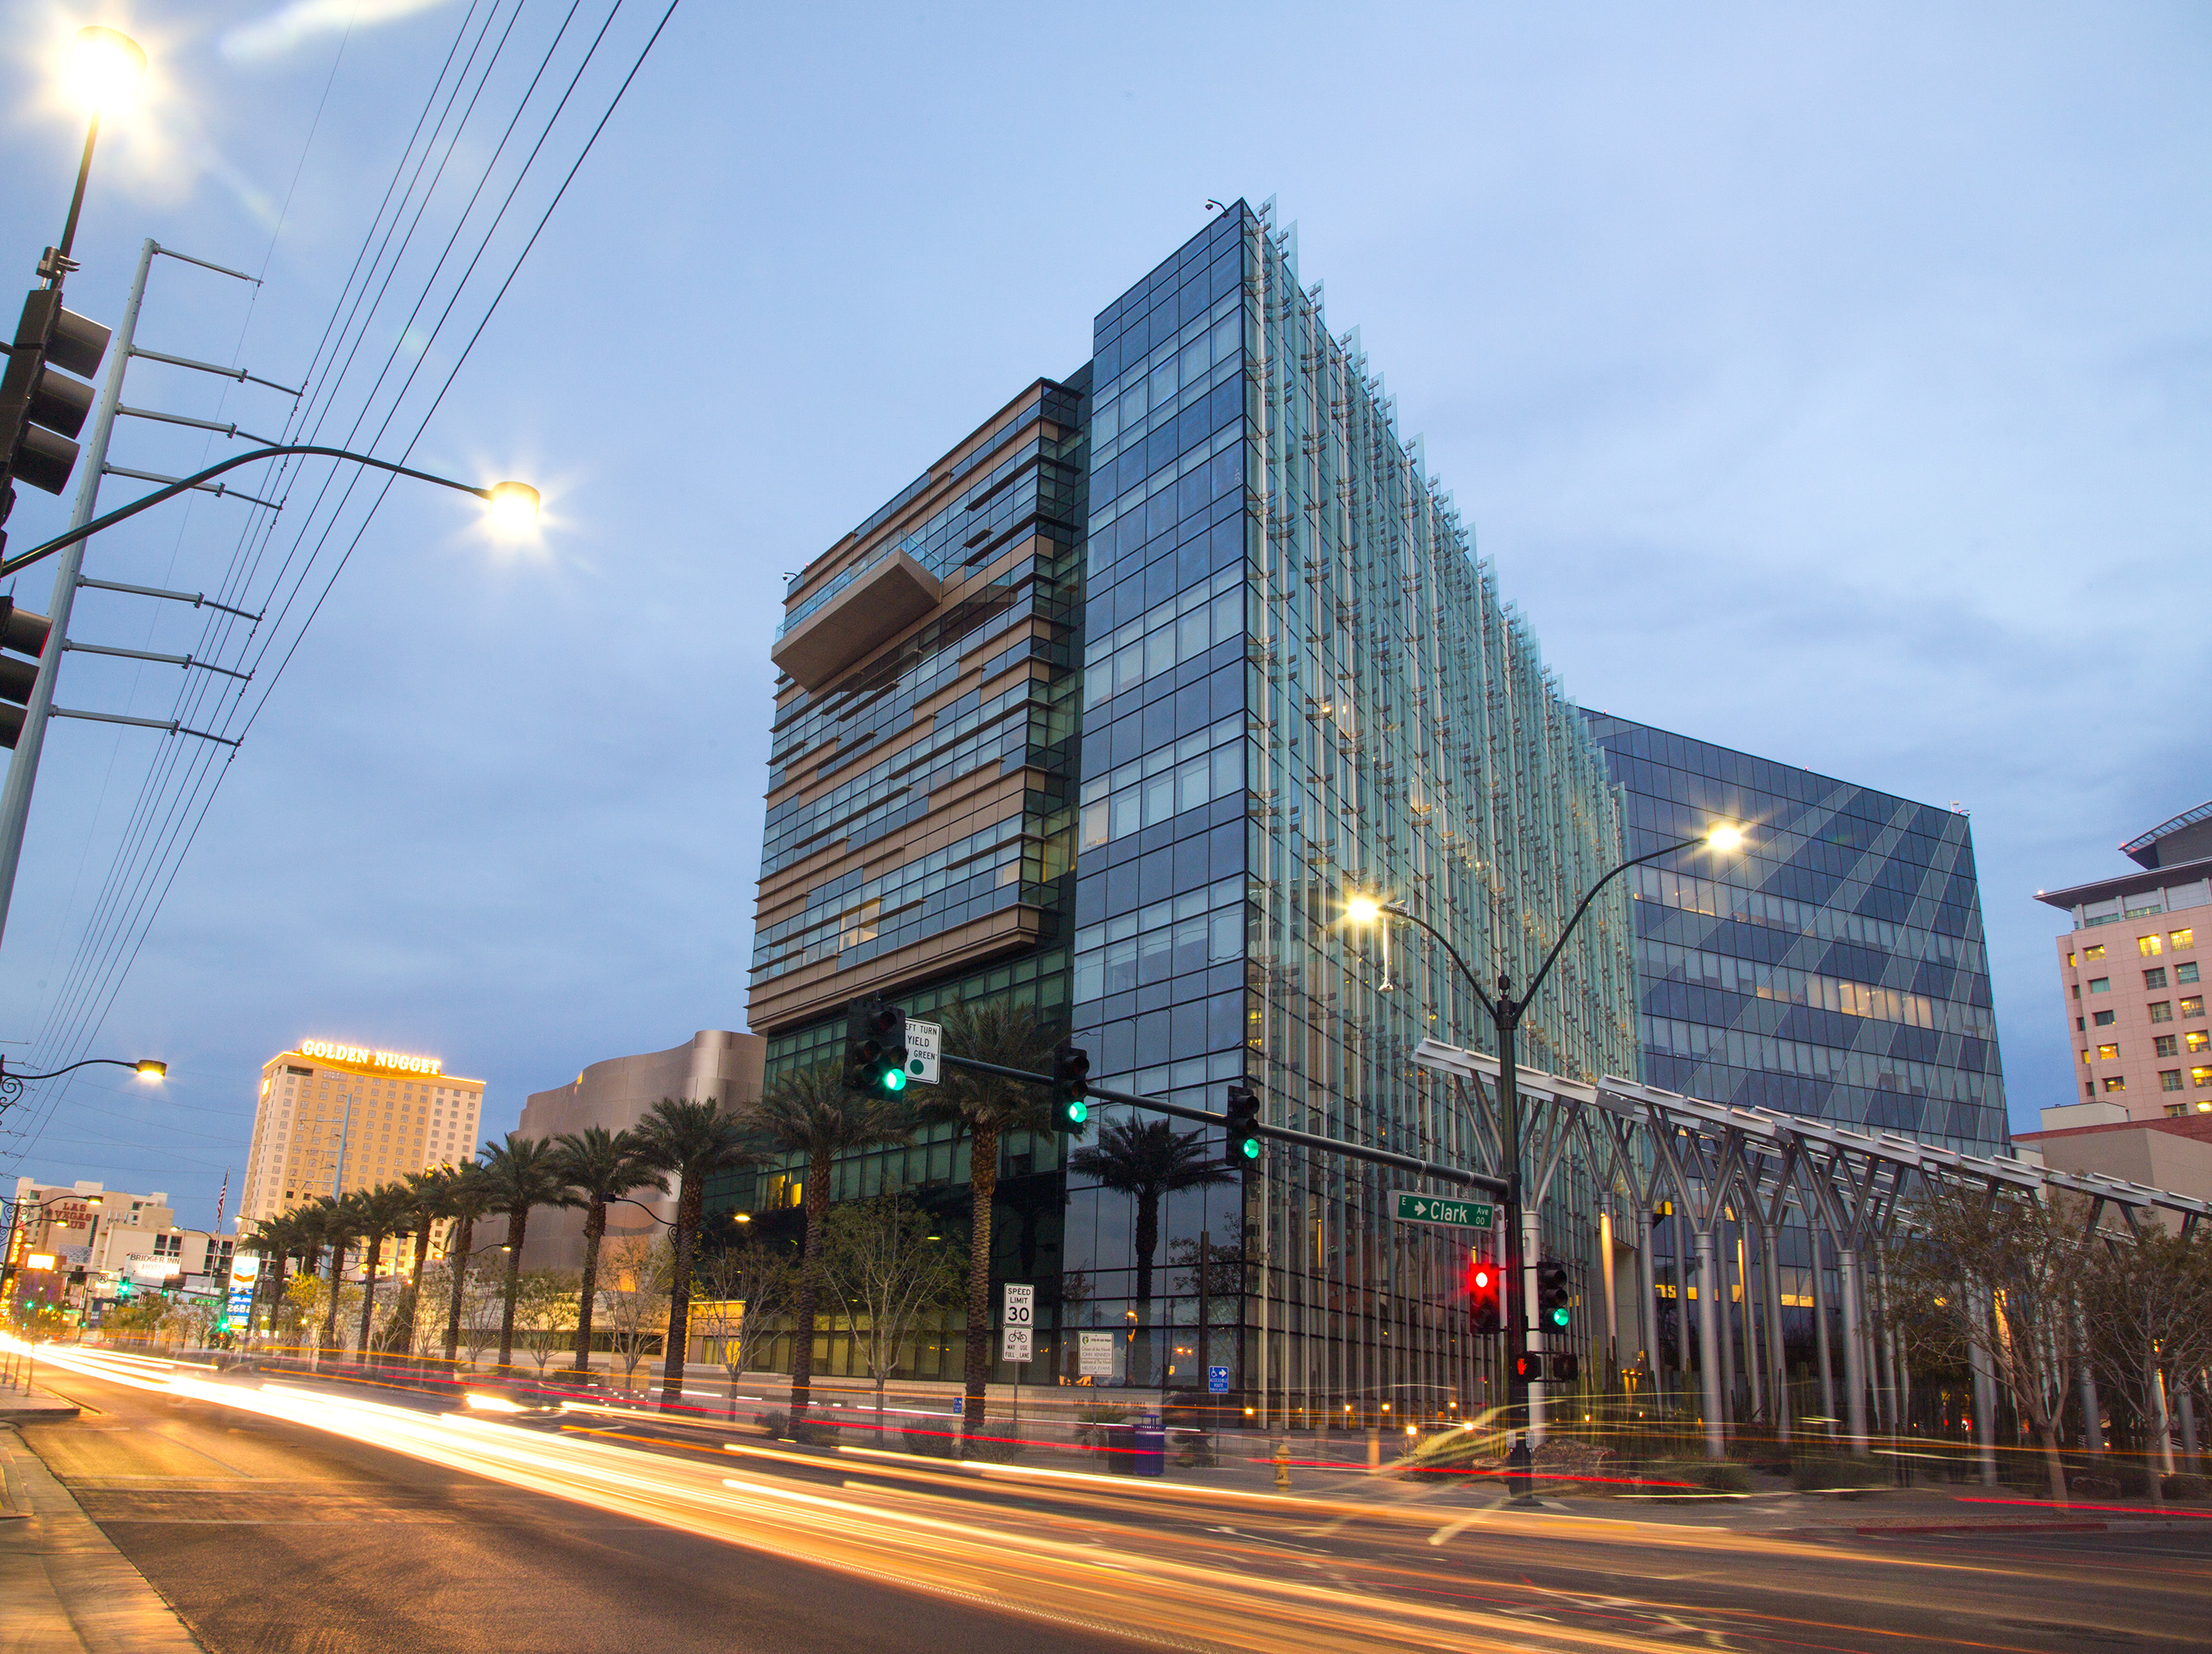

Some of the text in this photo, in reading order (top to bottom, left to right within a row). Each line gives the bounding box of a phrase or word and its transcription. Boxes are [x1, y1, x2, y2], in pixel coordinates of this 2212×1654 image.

[905, 1023, 937, 1035] EFT TURN
[907, 1035, 930, 1047] YIELD
[301, 1040, 441, 1075] GOLDEN NUGGET
[914, 1050, 935, 1060] GREEN
[63, 1202, 87, 1212] LAS
[1401, 1197, 1489, 1223] E Clark Ave
[54, 1210, 93, 1222] VEGAS
[1476, 1216, 1486, 1226] 00
[130, 1254, 181, 1265] BRIDGER INN
[142, 1263, 168, 1272] HOTEL
[1008, 1288, 1031, 1296] SPEED
[1008, 1307, 1029, 1322] 30
